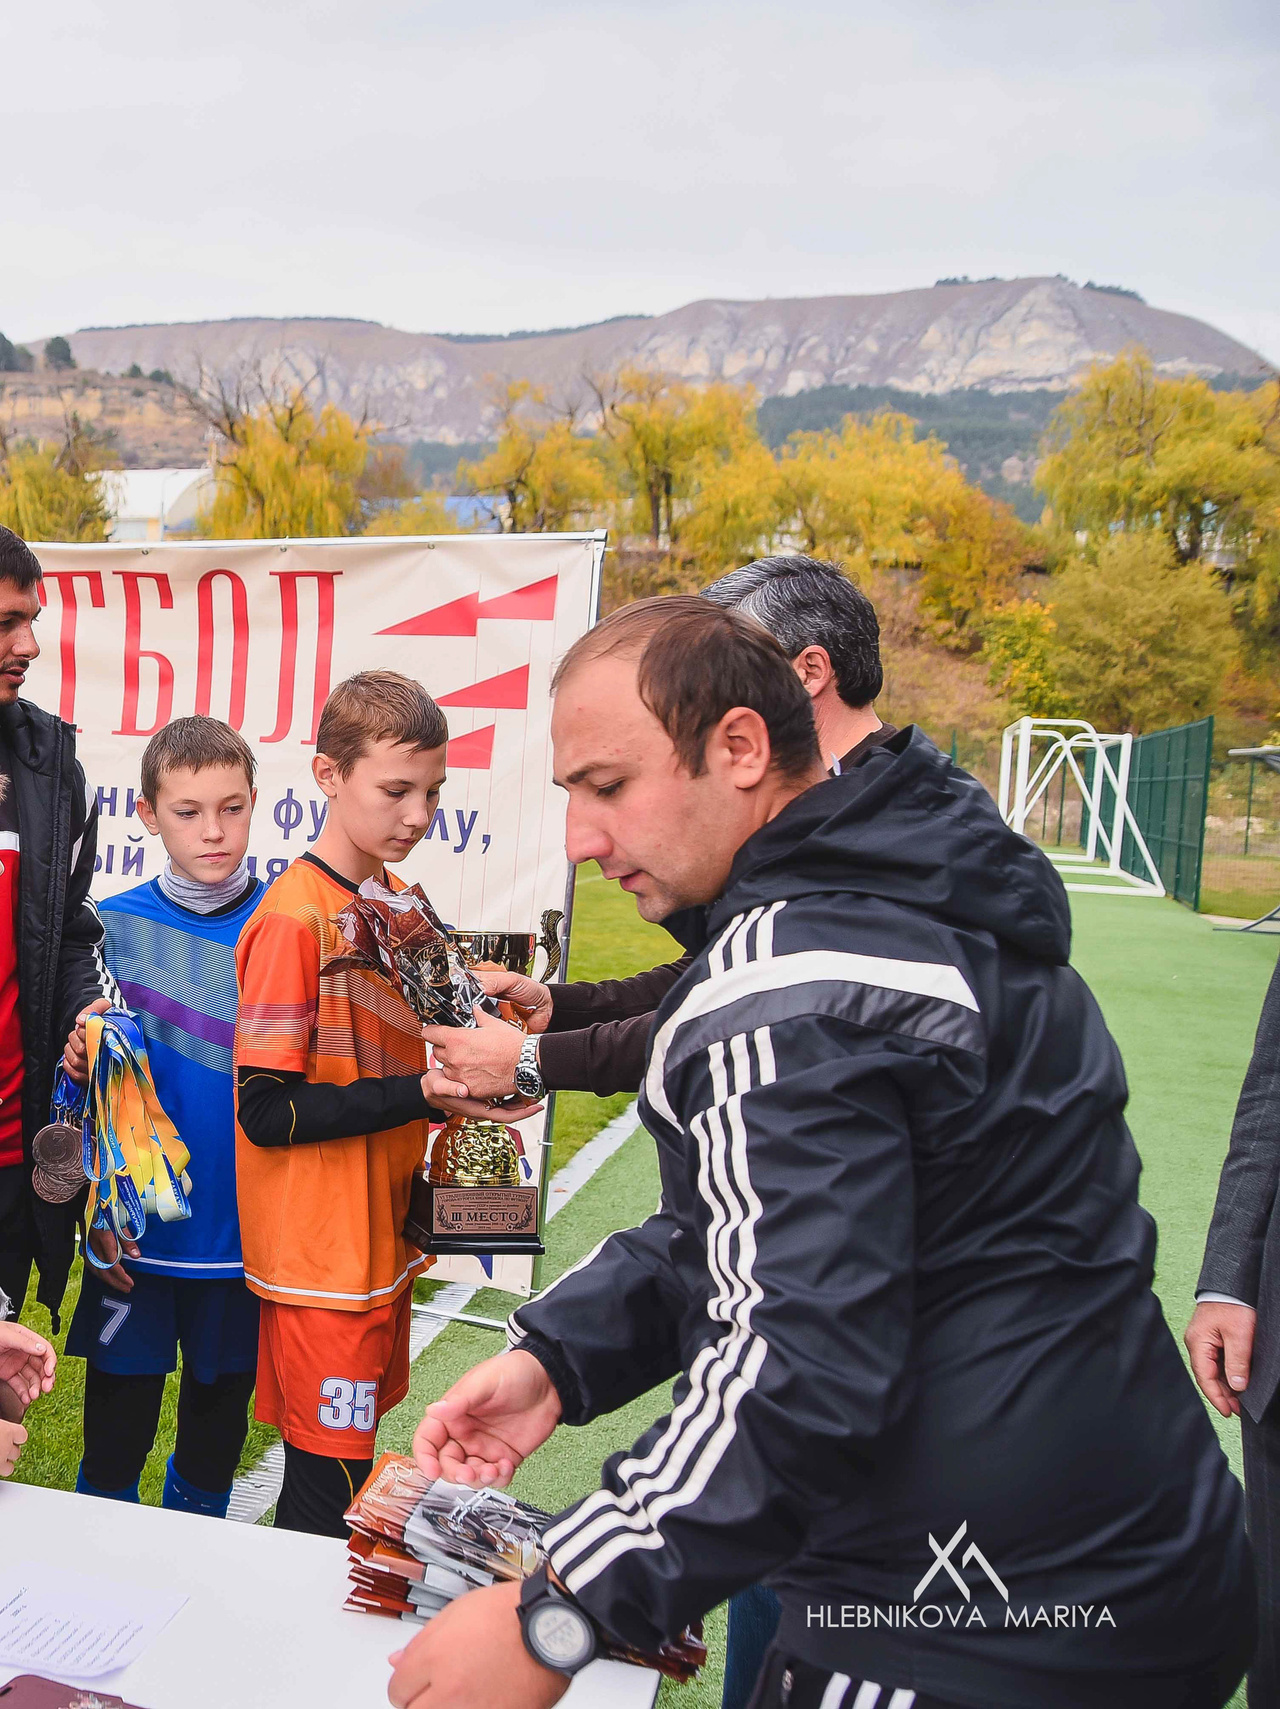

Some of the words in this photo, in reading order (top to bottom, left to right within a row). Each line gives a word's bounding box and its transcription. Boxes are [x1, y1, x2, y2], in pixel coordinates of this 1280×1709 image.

[467, 1212, 518, 1222] МЕСТО
[98, 1296, 132, 1346] 7
[318, 1377, 377, 1431] 35
